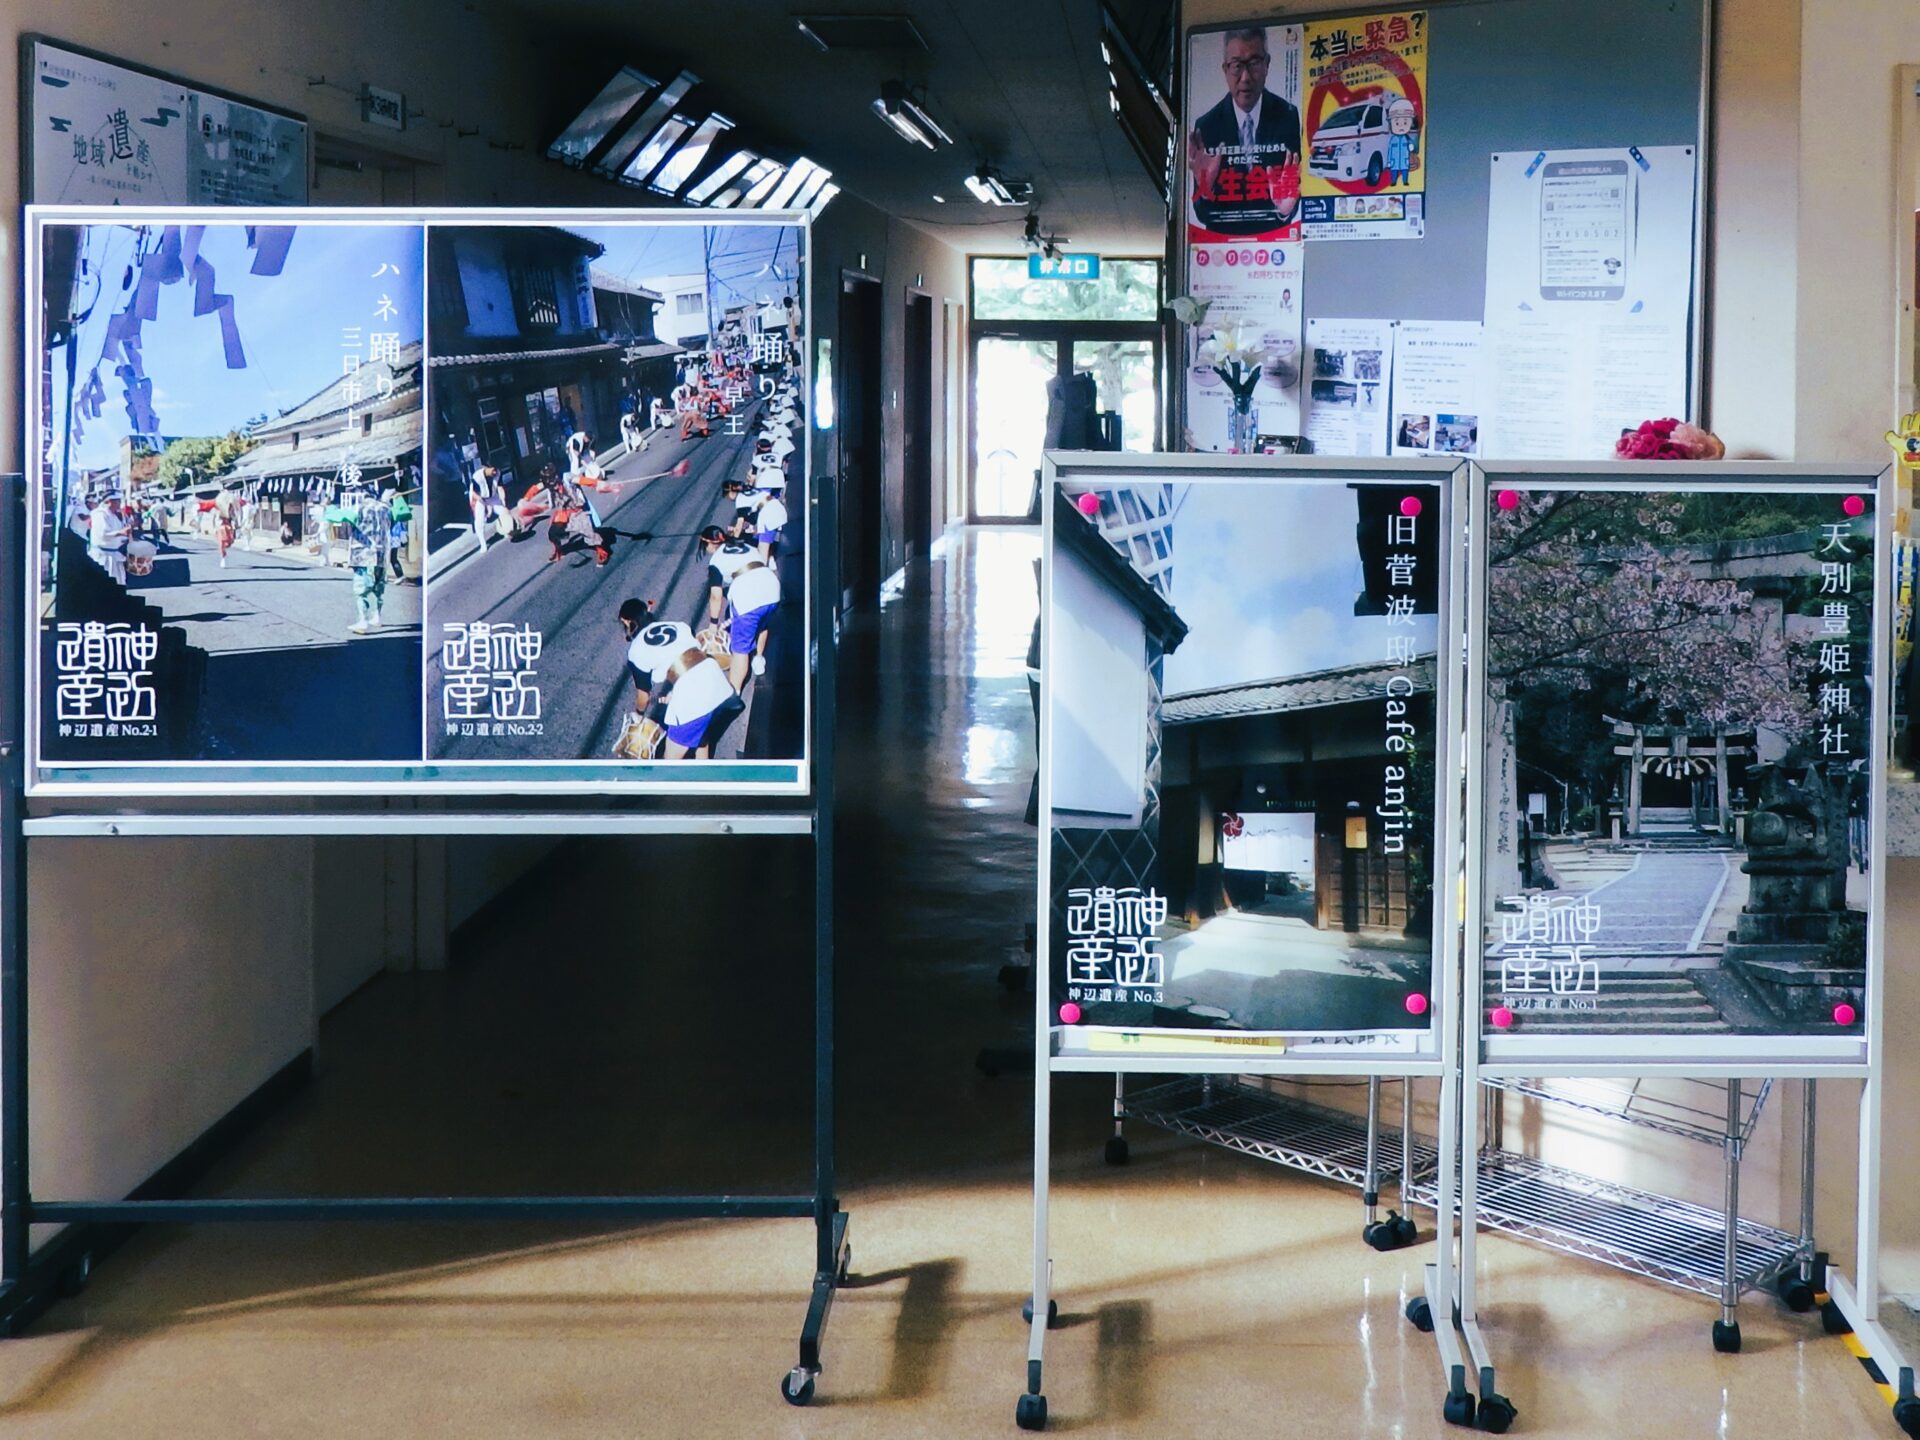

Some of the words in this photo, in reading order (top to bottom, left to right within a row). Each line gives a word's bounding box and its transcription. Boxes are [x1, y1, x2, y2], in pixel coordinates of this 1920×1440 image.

[1309, 13, 1424, 61] 本当に緊急?
[73, 107, 150, 169] 地域遺産
[368, 262, 402, 400] ハネ踊り
[752, 263, 783, 401] ハネ踊り
[723, 386, 746, 436] 早王
[1385, 515, 1417, 667] 旧菅波邸
[1819, 522, 1852, 756] 天別豊姫神社
[121, 723, 159, 737] No.2-1
[505, 723, 544, 737] No.2-2
[1376, 766, 1413, 854] anjin
[1134, 990, 1163, 1003] No.3
[1568, 998, 1598, 1010] No.1
